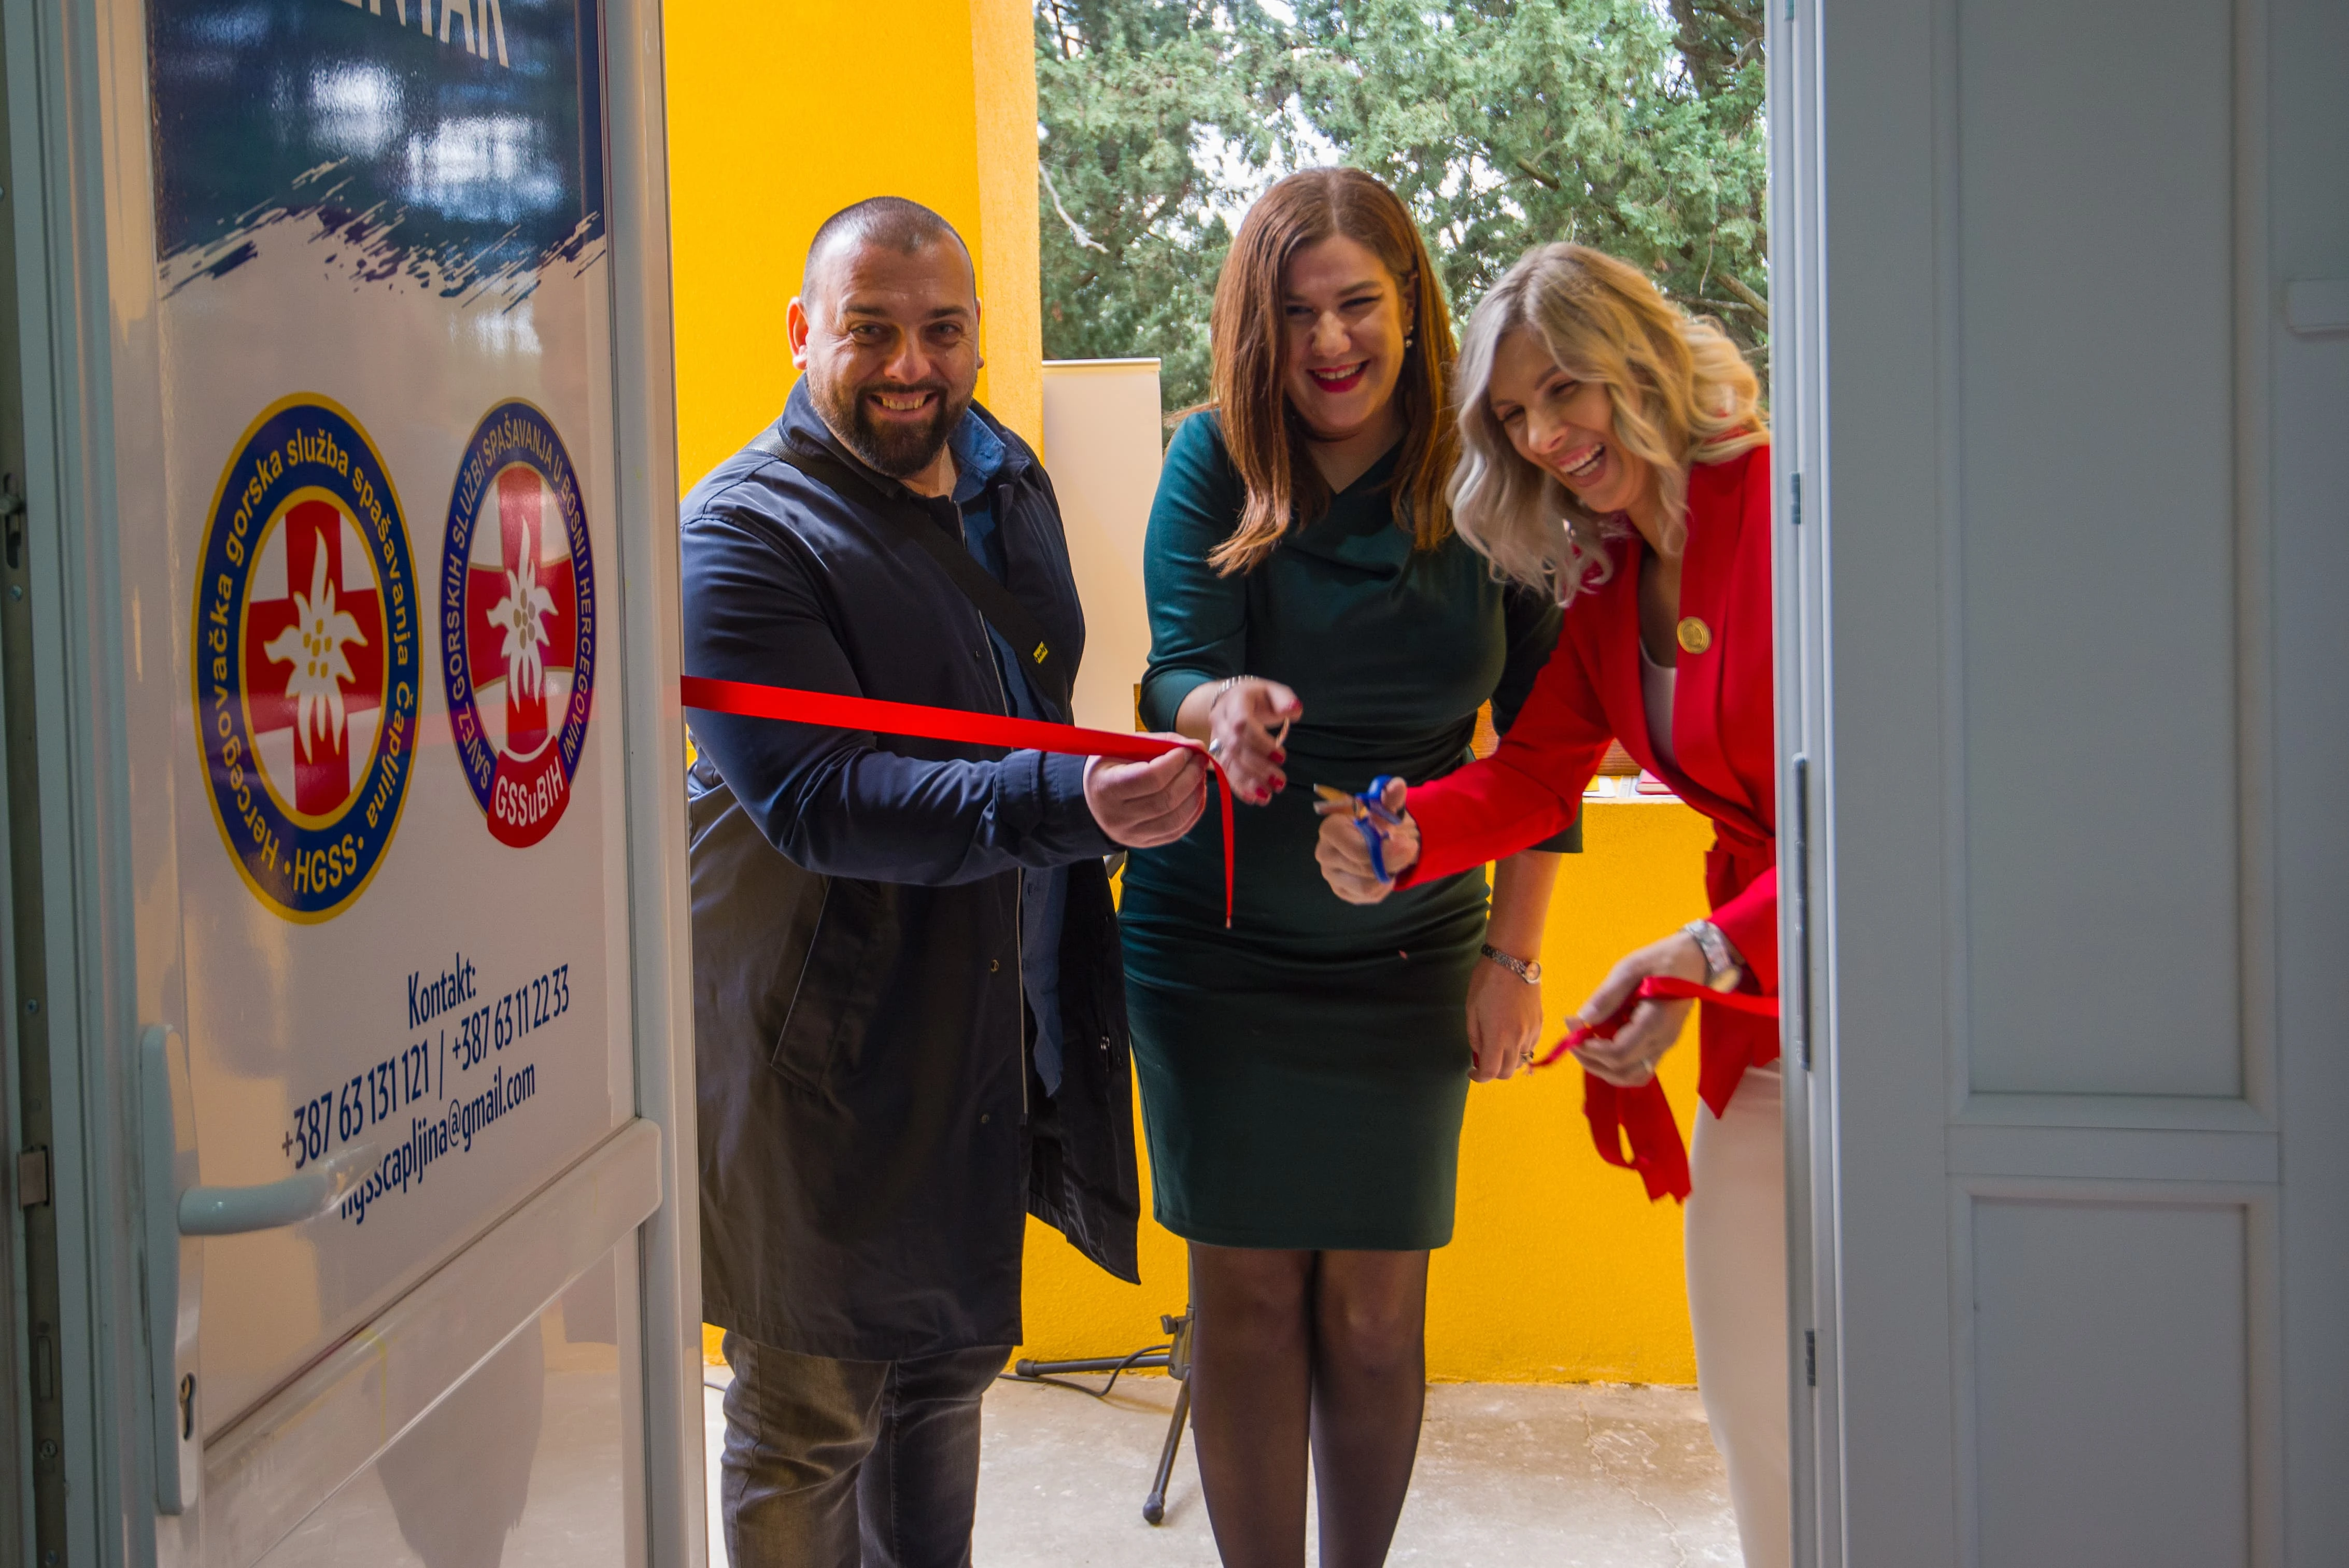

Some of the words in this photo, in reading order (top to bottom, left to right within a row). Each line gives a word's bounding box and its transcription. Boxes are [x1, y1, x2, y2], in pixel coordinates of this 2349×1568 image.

[287, 428, 349, 477] služba
[483, 413, 553, 471] SPAŠAVANJA
[553, 454, 562, 483] U
[225, 450, 284, 567] gorska
[452, 450, 485, 549] SLUŽBI
[560, 474, 587, 558] BOSNI
[353, 467, 412, 666] spašavanja
[578, 560, 588, 572] I
[447, 554, 465, 700] GORSKIH
[563, 576, 592, 764] HERCEGOVINI
[209, 574, 280, 871] Hercegovačka
[365, 681, 413, 828] Čapljina
[458, 702, 490, 789] SAVEZ
[495, 755, 564, 827] GSSuBIH
[292, 834, 358, 894] HGSS
[408, 952, 476, 1030] Kontakt:
[281, 1091, 333, 1169] +387
[339, 1075, 363, 1142] 63
[452, 1005, 490, 1071] +387
